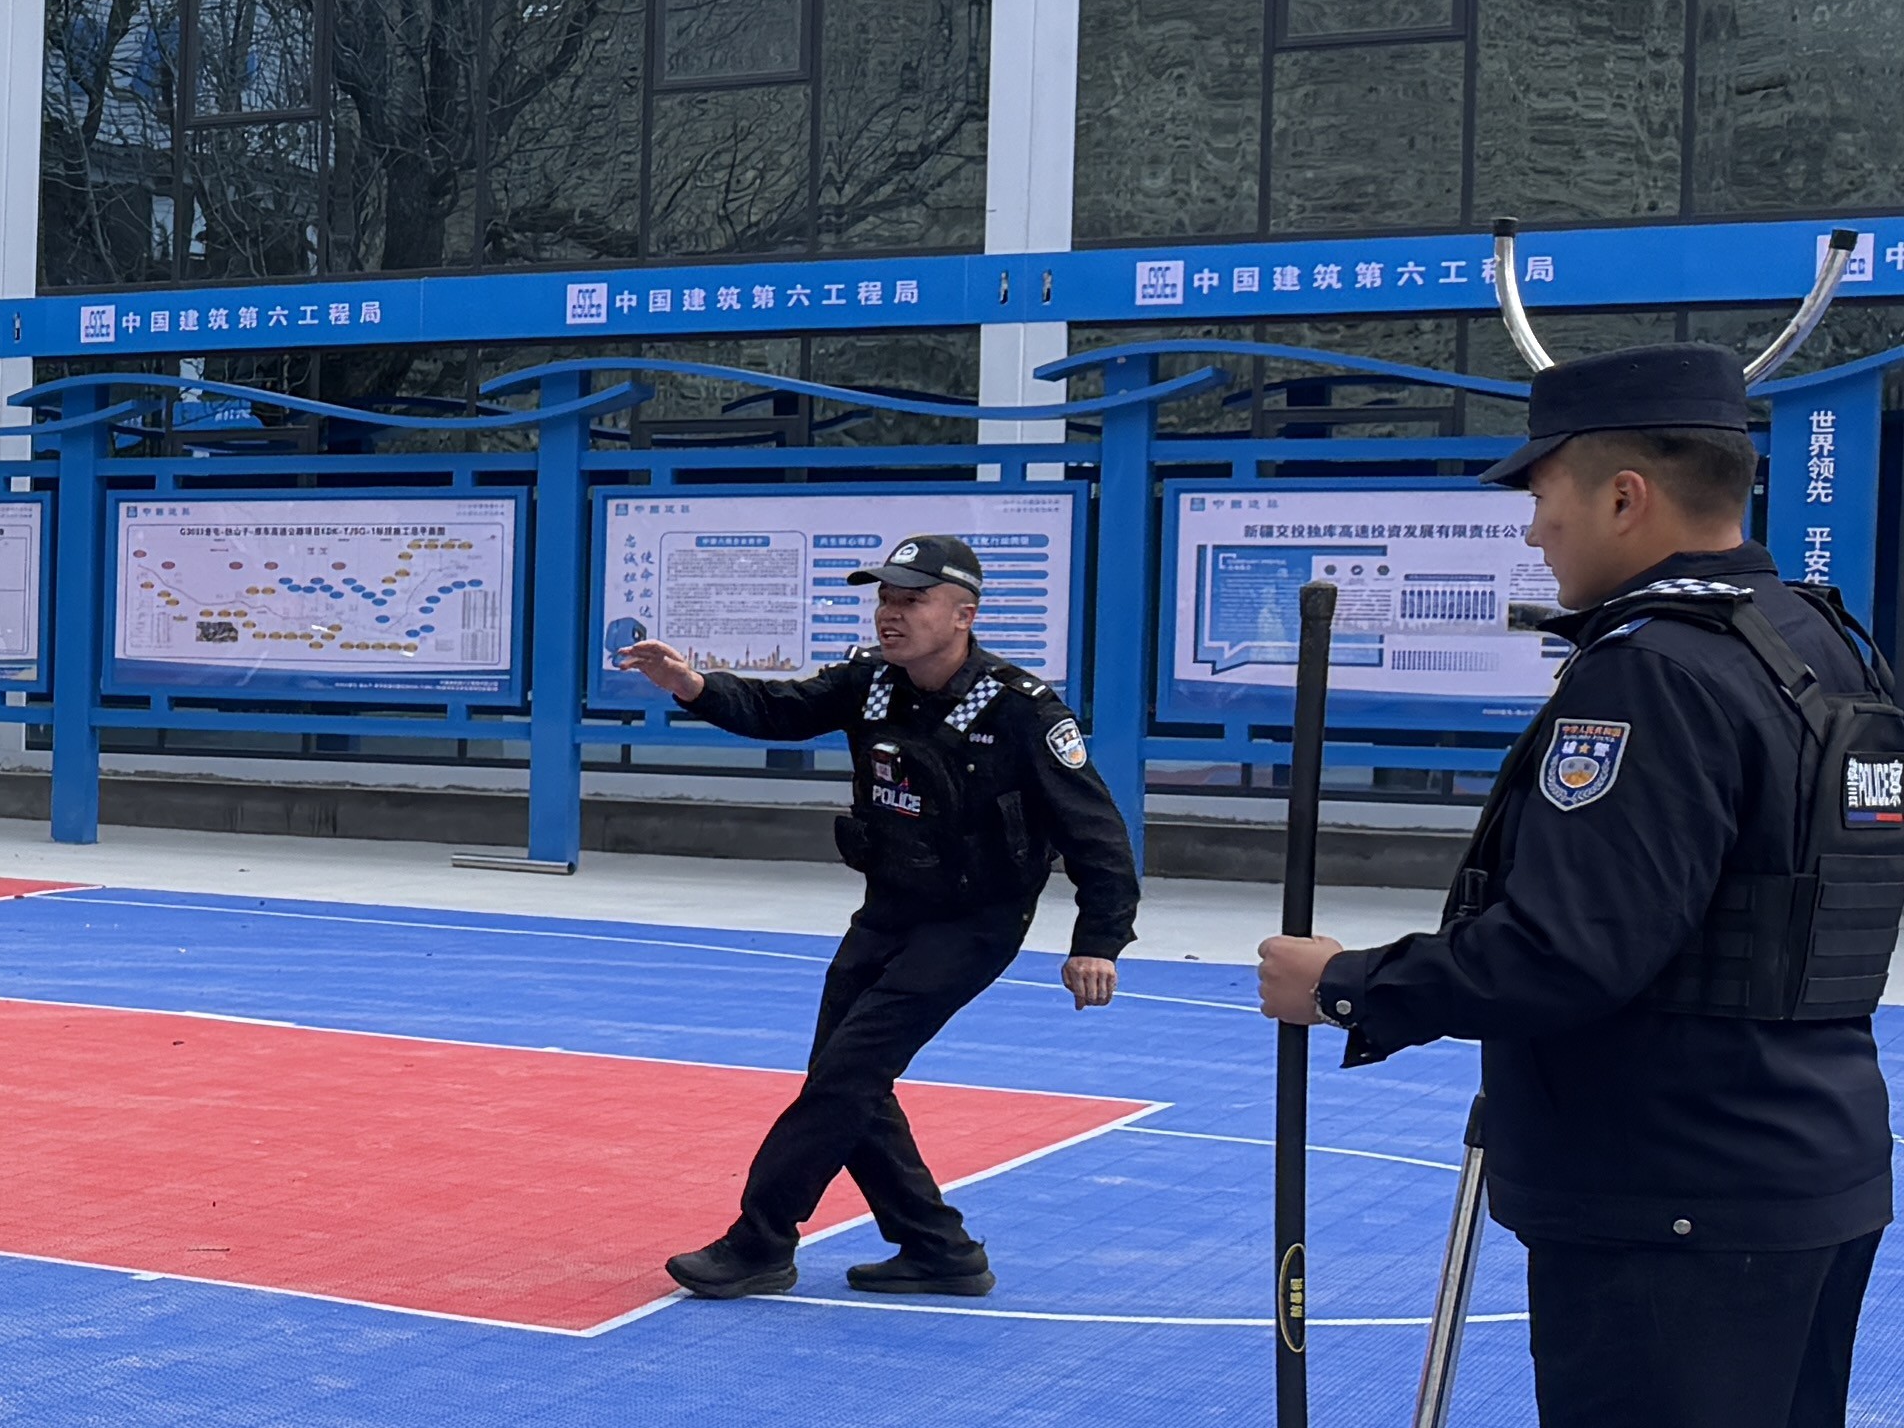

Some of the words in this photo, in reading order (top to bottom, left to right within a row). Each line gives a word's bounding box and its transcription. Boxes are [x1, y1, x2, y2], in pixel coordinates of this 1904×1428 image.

[615, 280, 918, 314] 中国建筑第六工程局
[122, 301, 381, 333] 中国建筑第六工程局
[1806, 410, 1836, 503] 世界领先
[872, 784, 922, 813] POLICE
